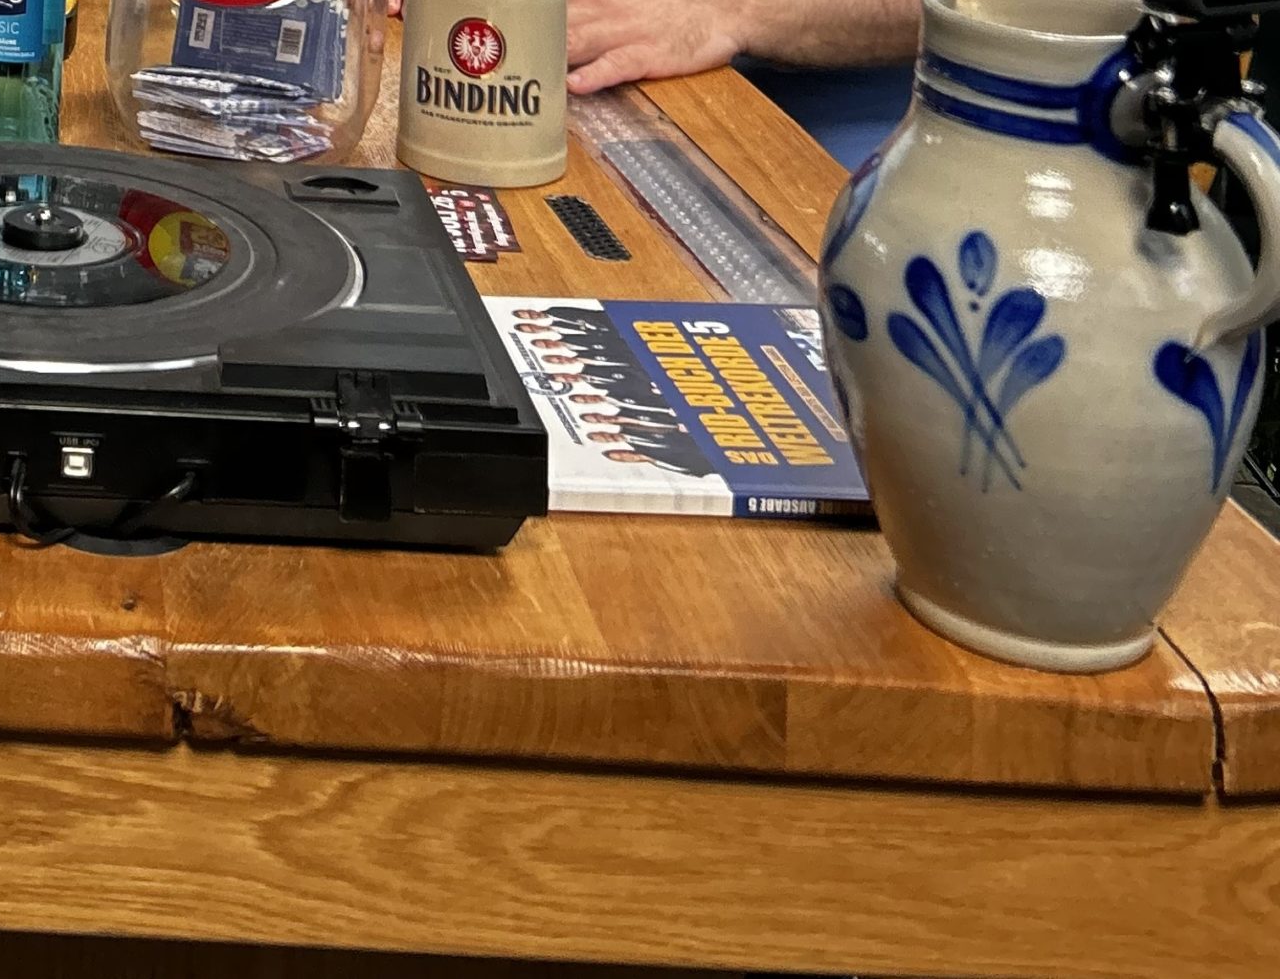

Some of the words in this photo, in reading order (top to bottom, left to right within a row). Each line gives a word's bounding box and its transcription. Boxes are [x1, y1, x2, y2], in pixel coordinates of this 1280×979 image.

[416, 65, 541, 116] BINDING
[632, 320, 695, 353] DER
[681, 320, 730, 335] 5
[653, 356, 767, 448] RID-BUCH
[697, 336, 834, 465] WELTREKORDE
[58, 436, 79, 446] USB
[723, 449, 779, 465] DAS
[760, 497, 816, 514] AUSGABE
